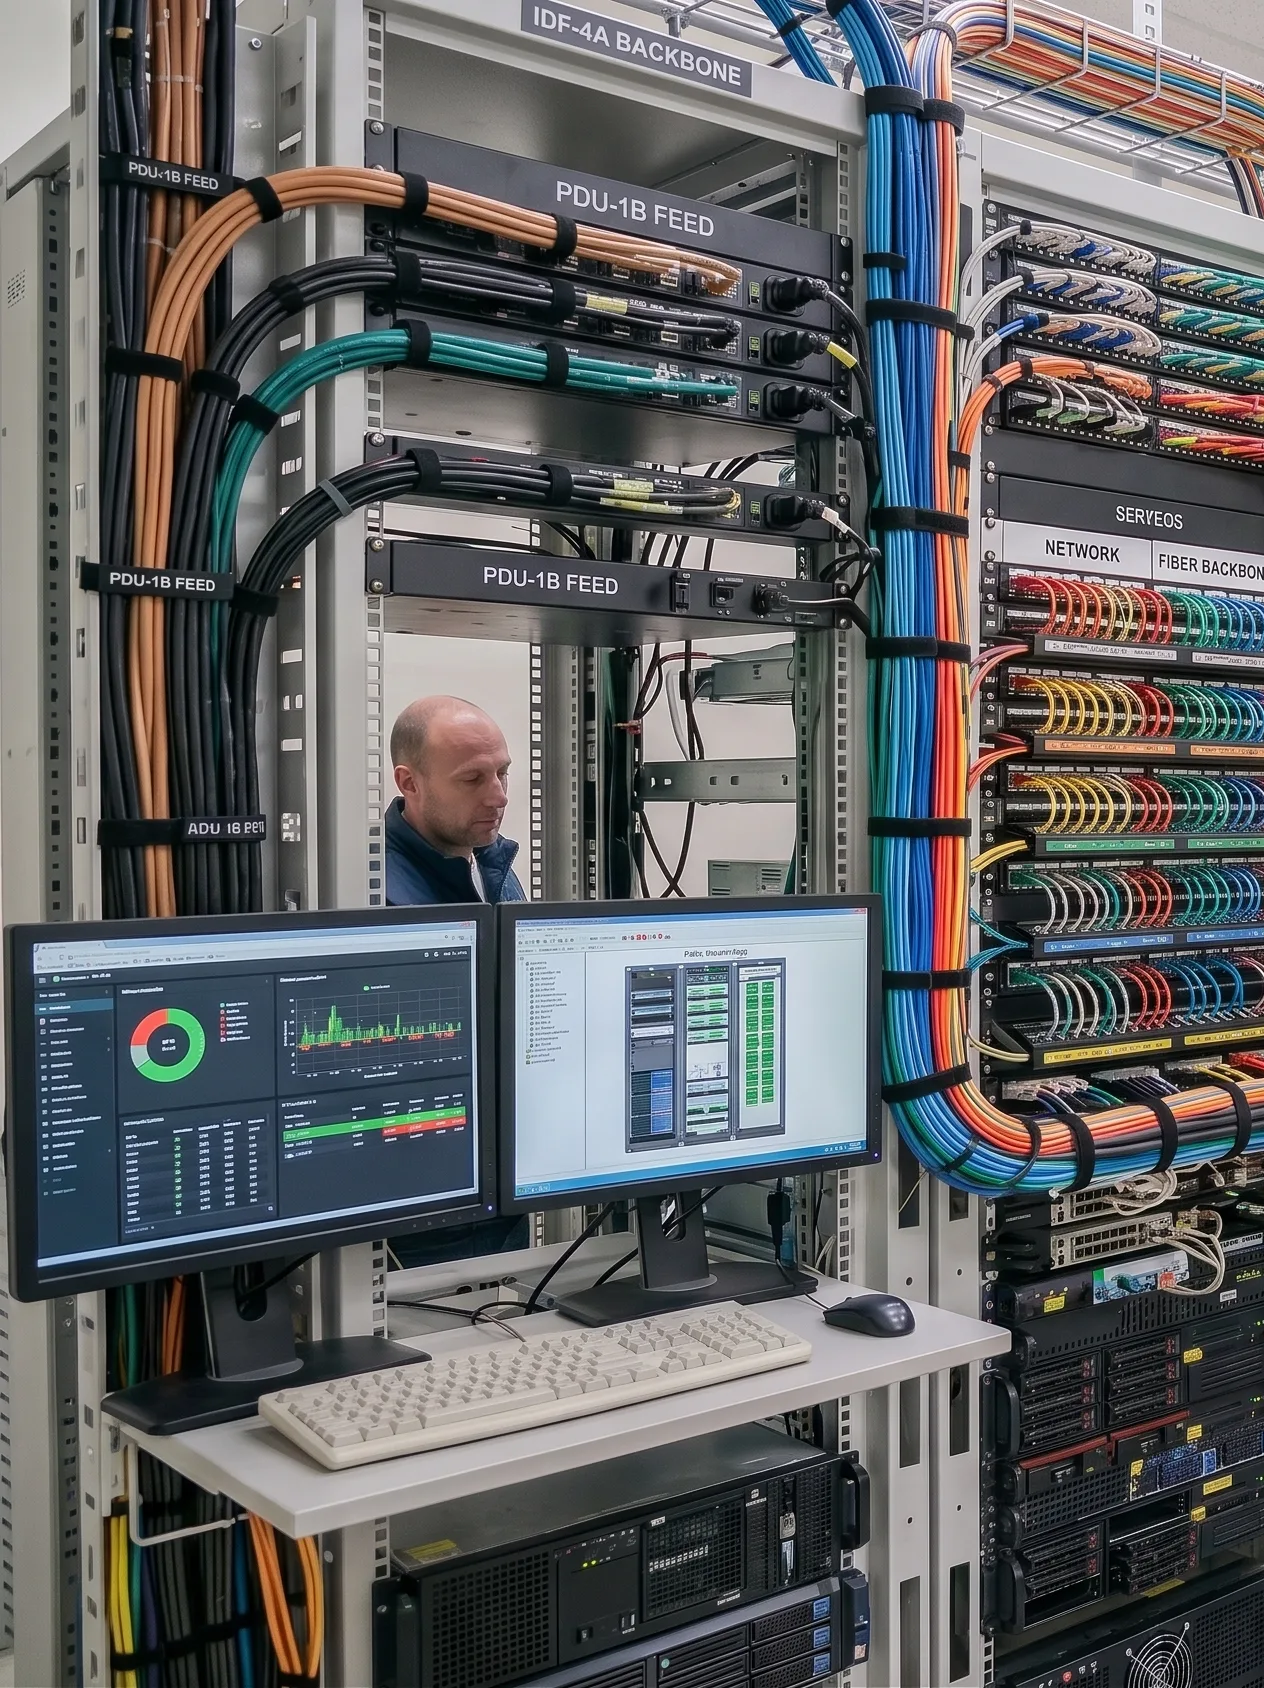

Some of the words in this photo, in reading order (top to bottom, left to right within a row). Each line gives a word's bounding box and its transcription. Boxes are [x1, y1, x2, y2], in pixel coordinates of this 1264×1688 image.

[534, 6, 610, 48] IDF-4A
[616, 31, 741, 86] BACKBONE
[184, 173, 219, 190] FEED
[556, 180, 647, 222] PDU-1B
[654, 204, 715, 237] FEED
[1045, 539, 1120, 563] NETWORK
[1158, 554, 1198, 573] FIBER
[109, 572, 171, 589] PDU-1B
[175, 577, 216, 592] FEED
[483, 566, 560, 590] PDU-1B
[566, 573, 619, 595] FEED
